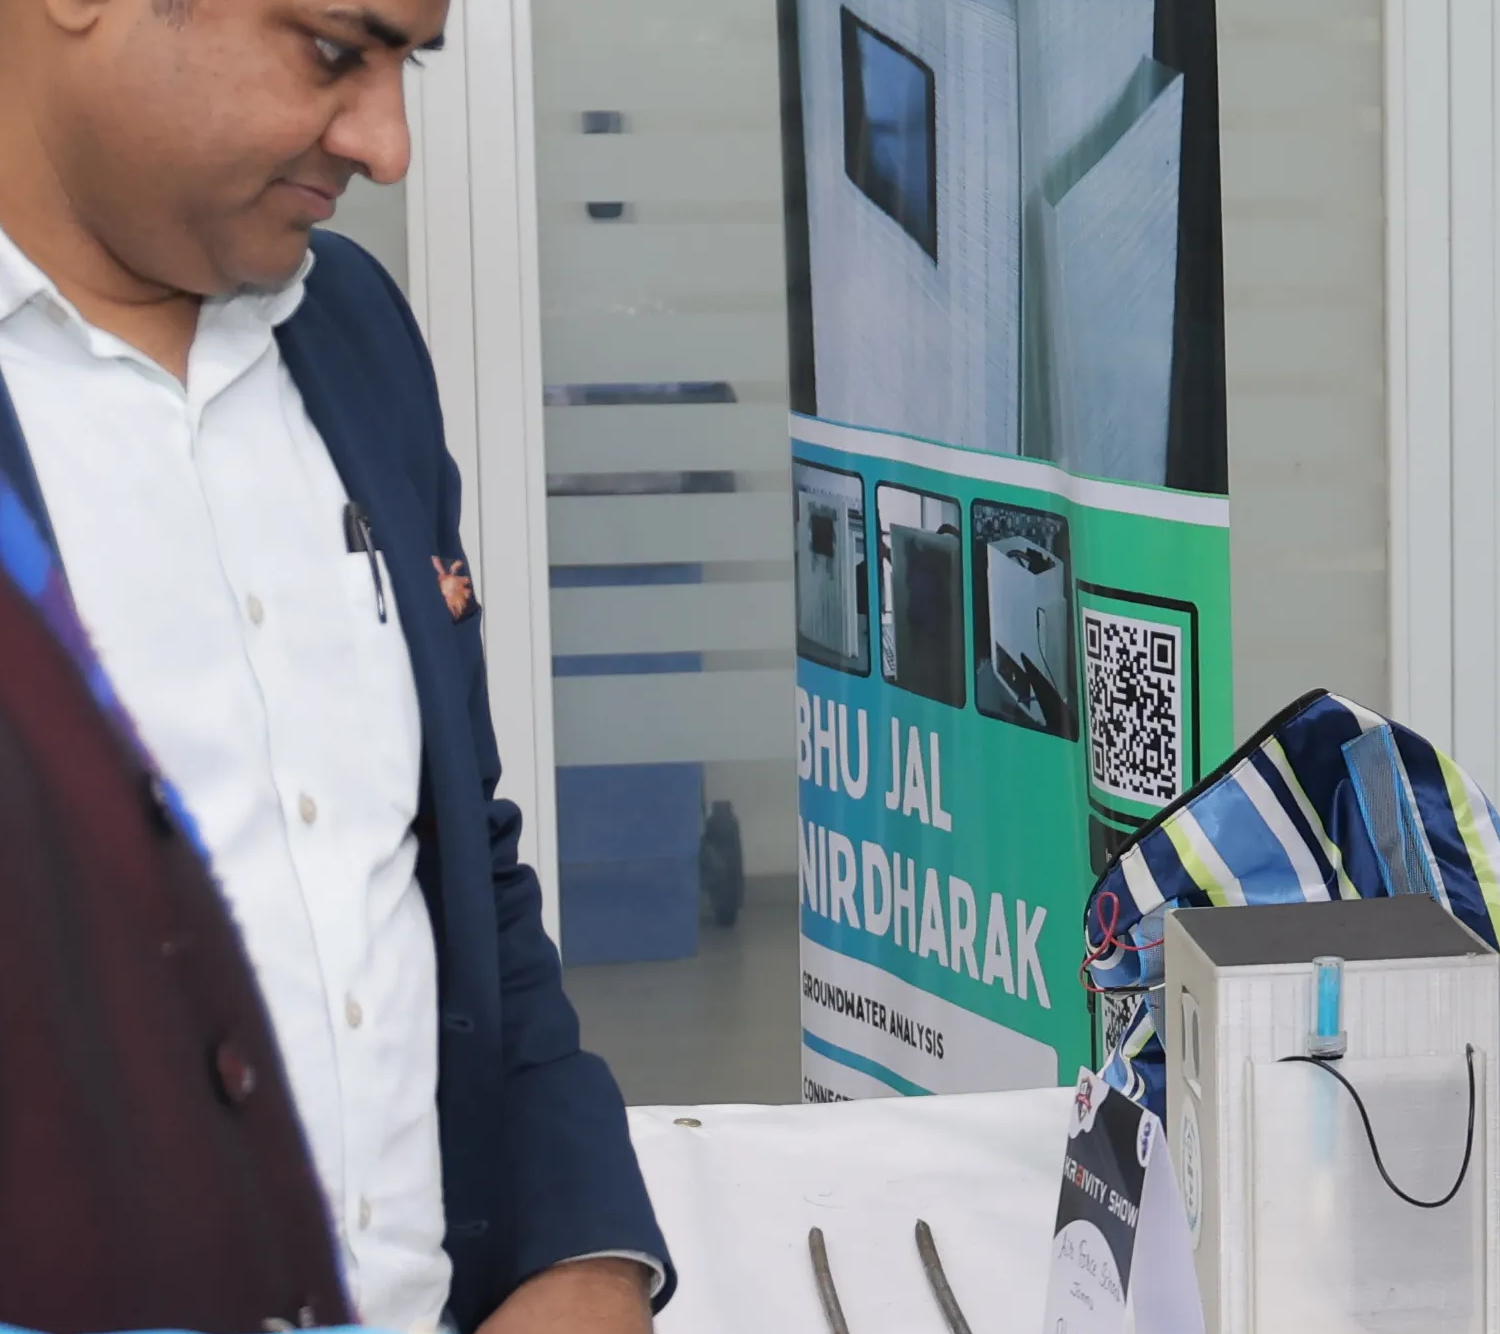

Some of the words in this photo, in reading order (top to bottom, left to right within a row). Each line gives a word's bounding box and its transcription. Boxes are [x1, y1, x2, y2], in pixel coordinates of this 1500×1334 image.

[795, 685, 869, 800] BHU
[885, 716, 952, 833] JAL
[799, 815, 1052, 1009] NIRDHARAK
[802, 969, 887, 1032] GROUNDWATER
[889, 1010, 945, 1060] ANALYSIS
[1107, 1189, 1140, 1228] SHOW
